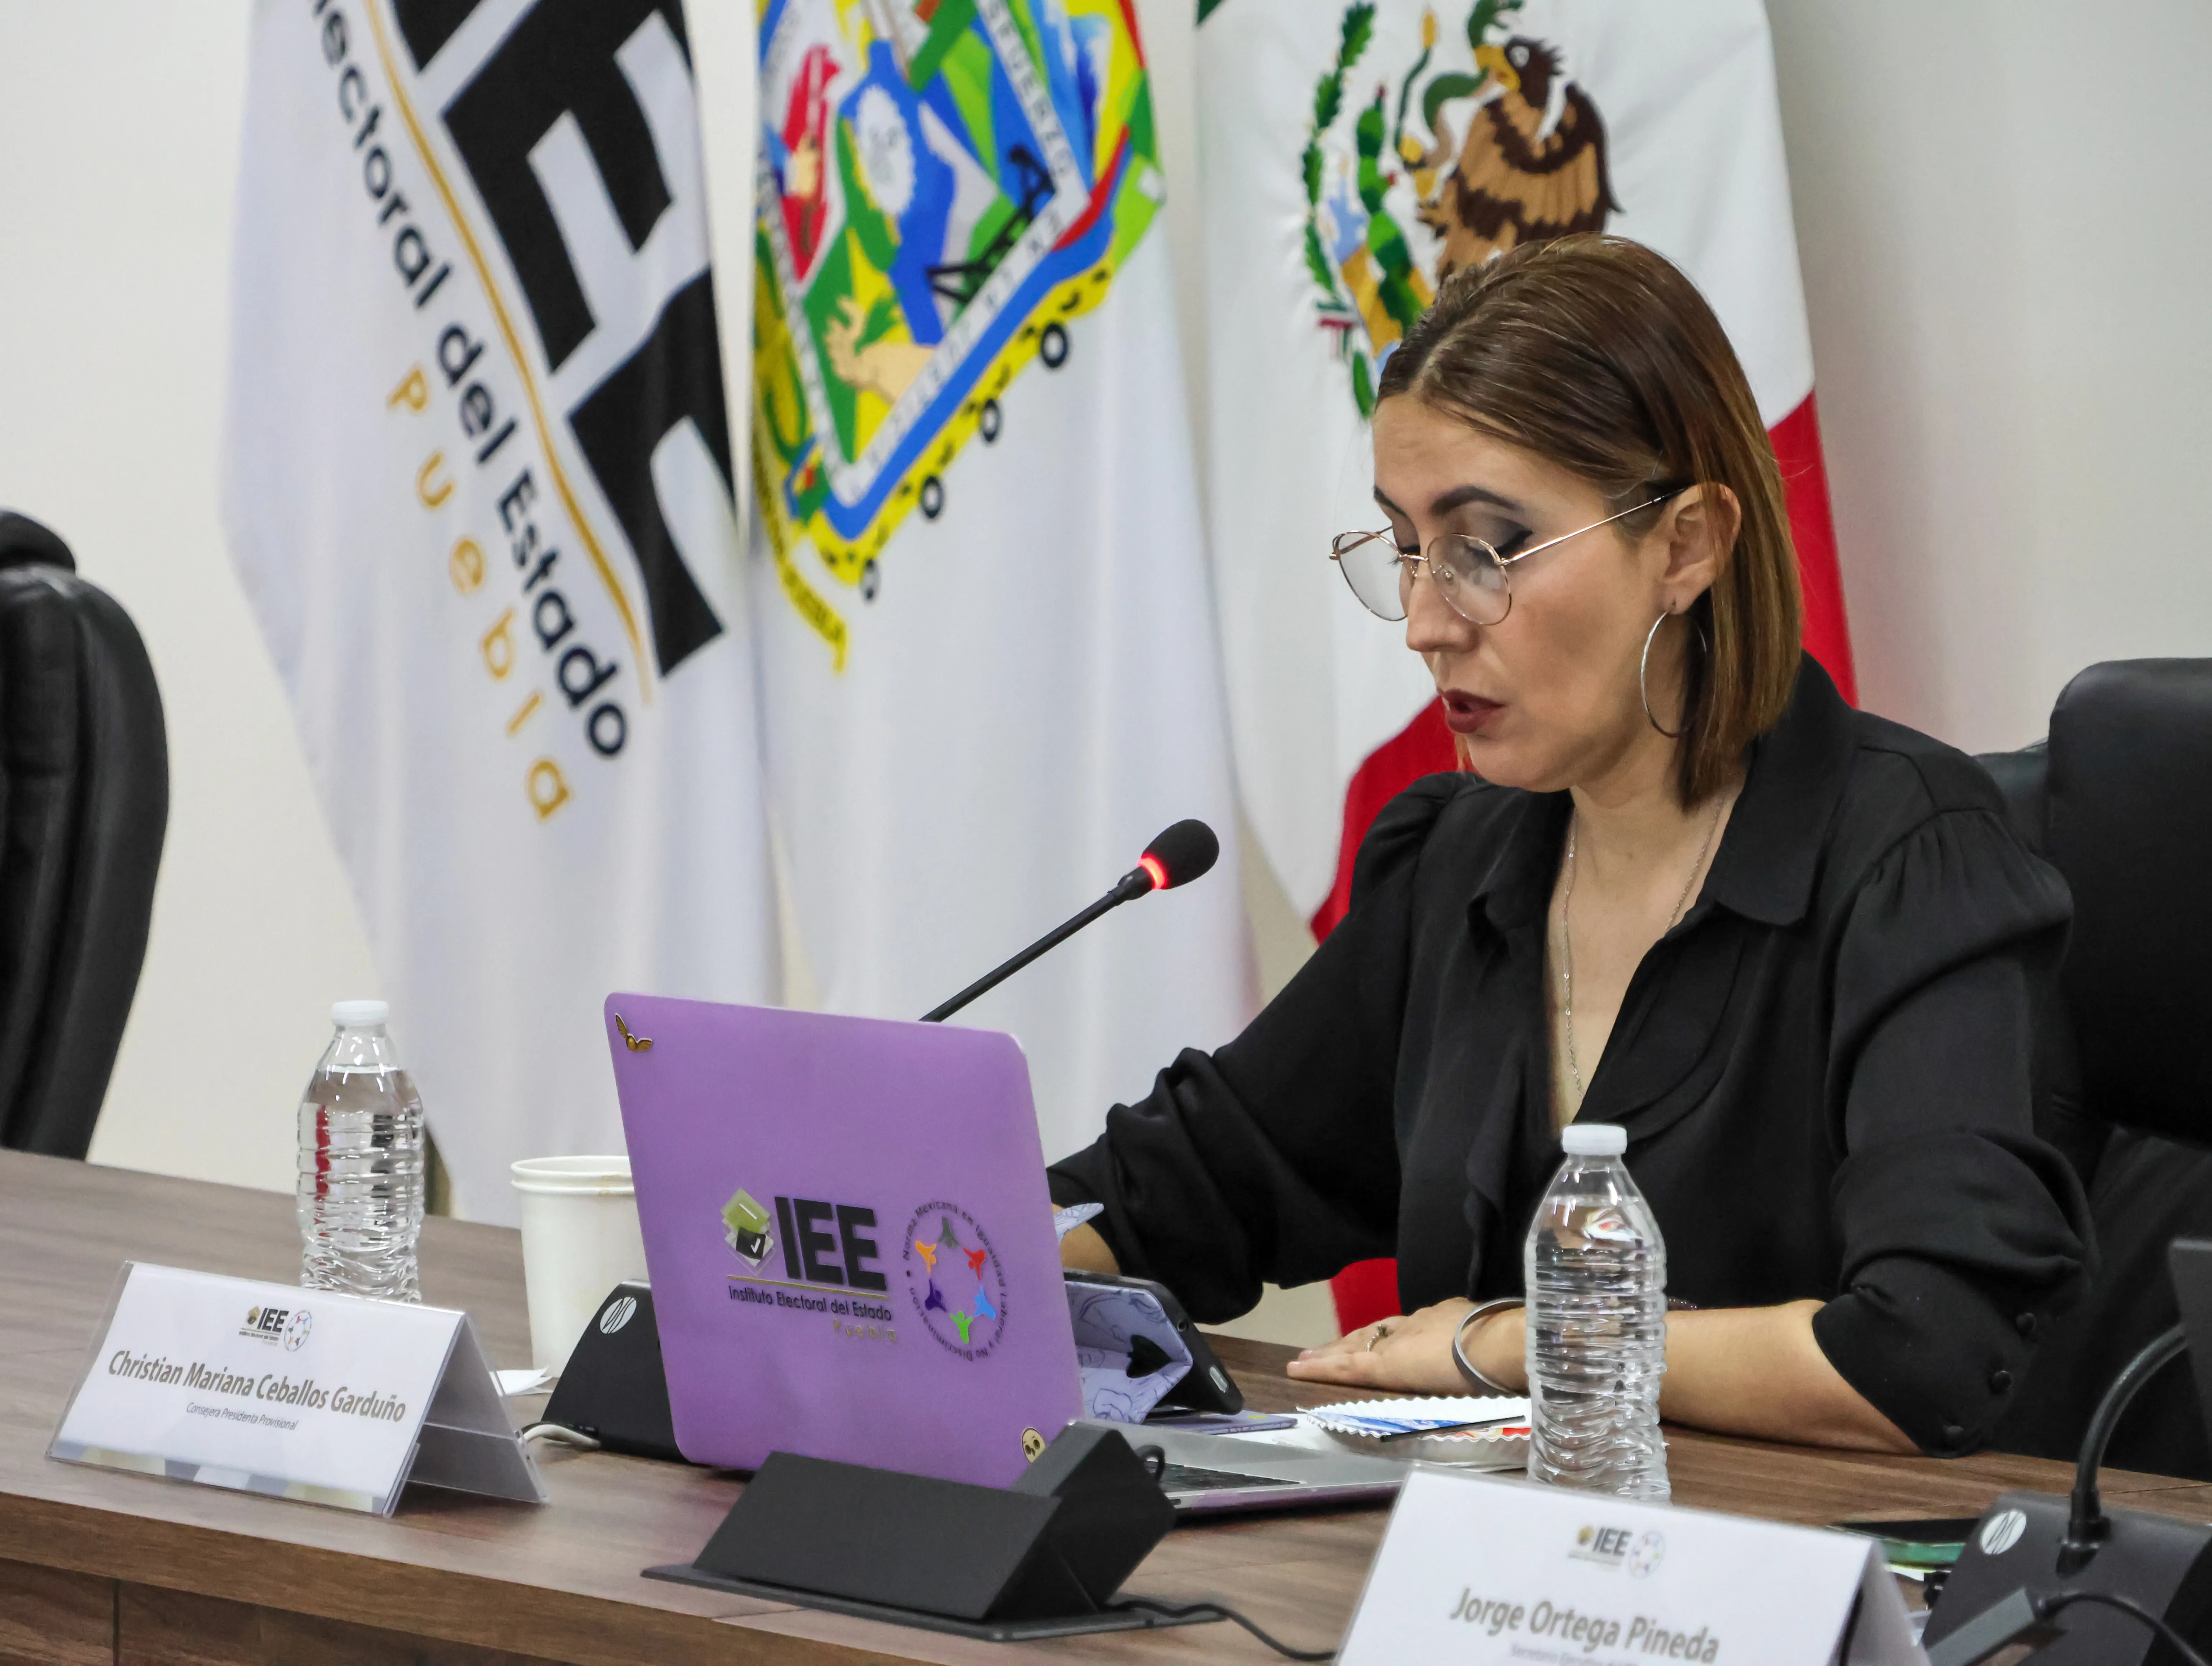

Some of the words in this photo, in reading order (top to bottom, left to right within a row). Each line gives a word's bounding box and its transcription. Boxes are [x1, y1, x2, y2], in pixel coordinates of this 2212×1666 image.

[436, 322, 520, 465] del
[495, 467, 628, 758] Estado
[387, 365, 571, 822] Puebla
[915, 1201, 959, 1218] Mexicana
[962, 1212, 973, 1225] en
[775, 1196, 887, 1291] IEE
[902, 1219, 917, 1261] Norma
[728, 1285, 773, 1305] Instituto
[776, 1291, 827, 1312] Electoral
[830, 1300, 850, 1315] del
[852, 1302, 892, 1321] Estado
[995, 1293, 1008, 1344] Laboral
[256, 1308, 289, 1333] IEE
[833, 1318, 896, 1342] Puebla
[975, 1349, 988, 1358] No
[988, 1340, 995, 1349] y
[108, 1350, 183, 1386] Christian
[184, 1362, 255, 1398] Mariana
[256, 1374, 330, 1409] Ceballos
[330, 1386, 406, 1423] Garduño
[187, 1402, 220, 1418] Consejera
[220, 1408, 259, 1424] Presidenta
[258, 1414, 299, 1430] Provisional
[1592, 1527, 1633, 1556] IEE
[1449, 1586, 1525, 1638] Jorge
[1529, 1600, 1619, 1653] Ortega
[1625, 1615, 1721, 1664] Pineda
